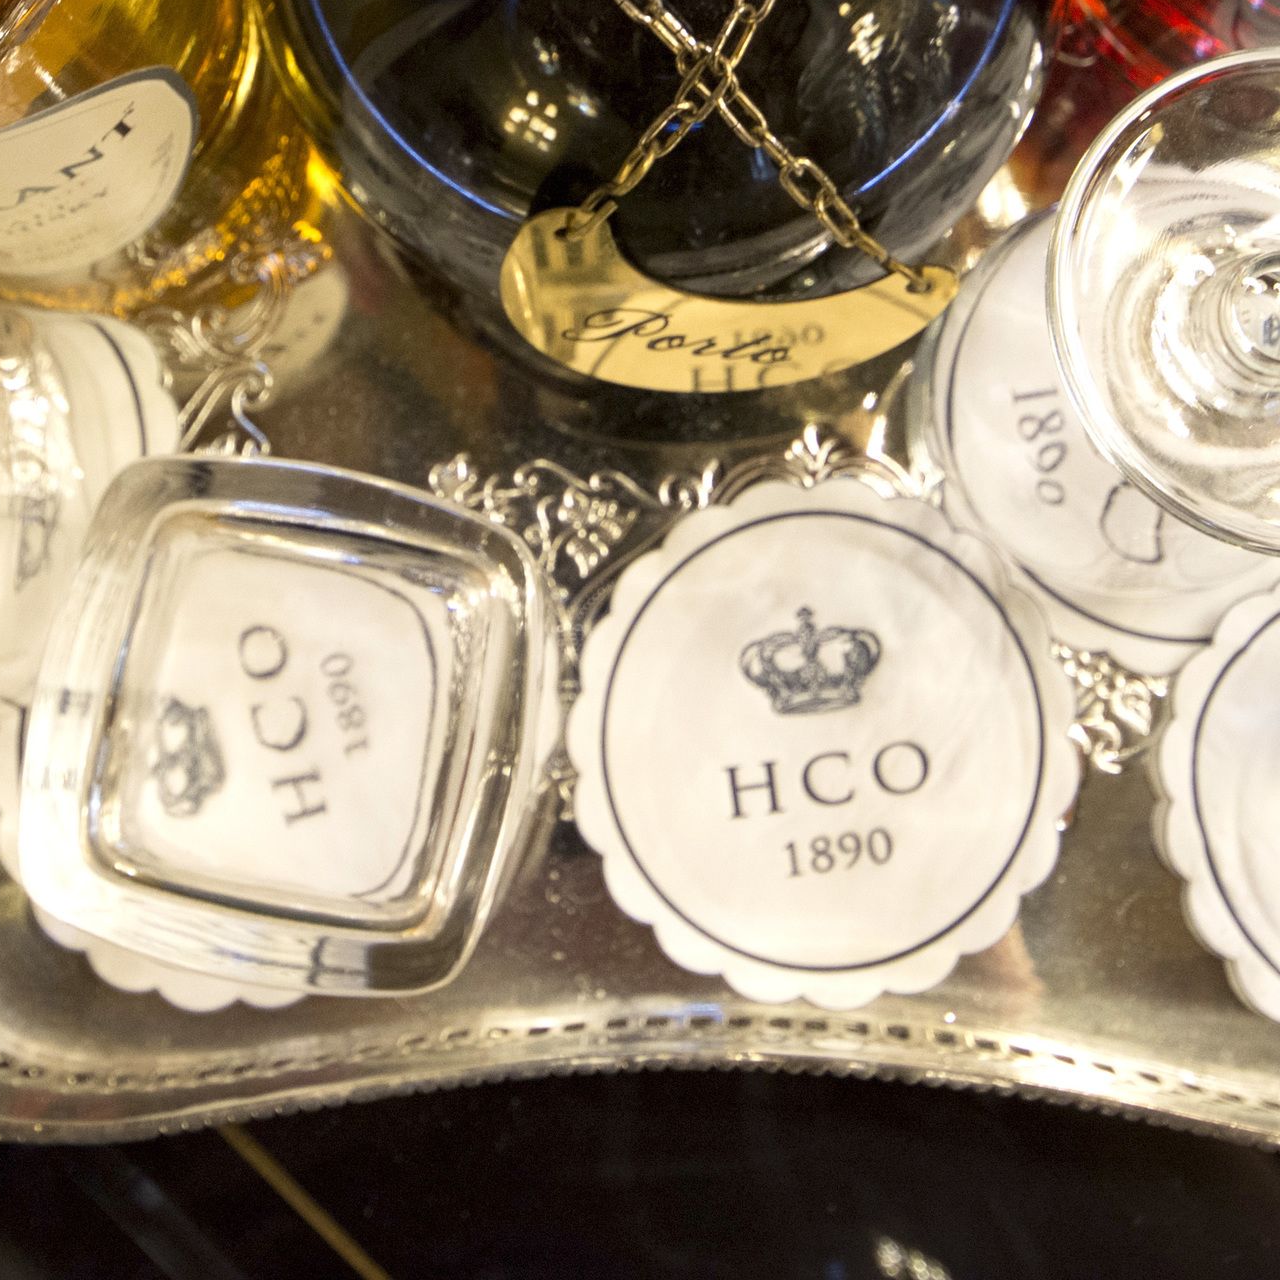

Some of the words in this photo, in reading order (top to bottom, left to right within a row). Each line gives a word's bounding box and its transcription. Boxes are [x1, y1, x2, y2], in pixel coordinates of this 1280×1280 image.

[561, 307, 791, 363] Porto
[238, 624, 329, 827] HCO
[320, 651, 369, 758] 1890
[724, 740, 931, 820] HCO
[783, 826, 894, 878] 1890
